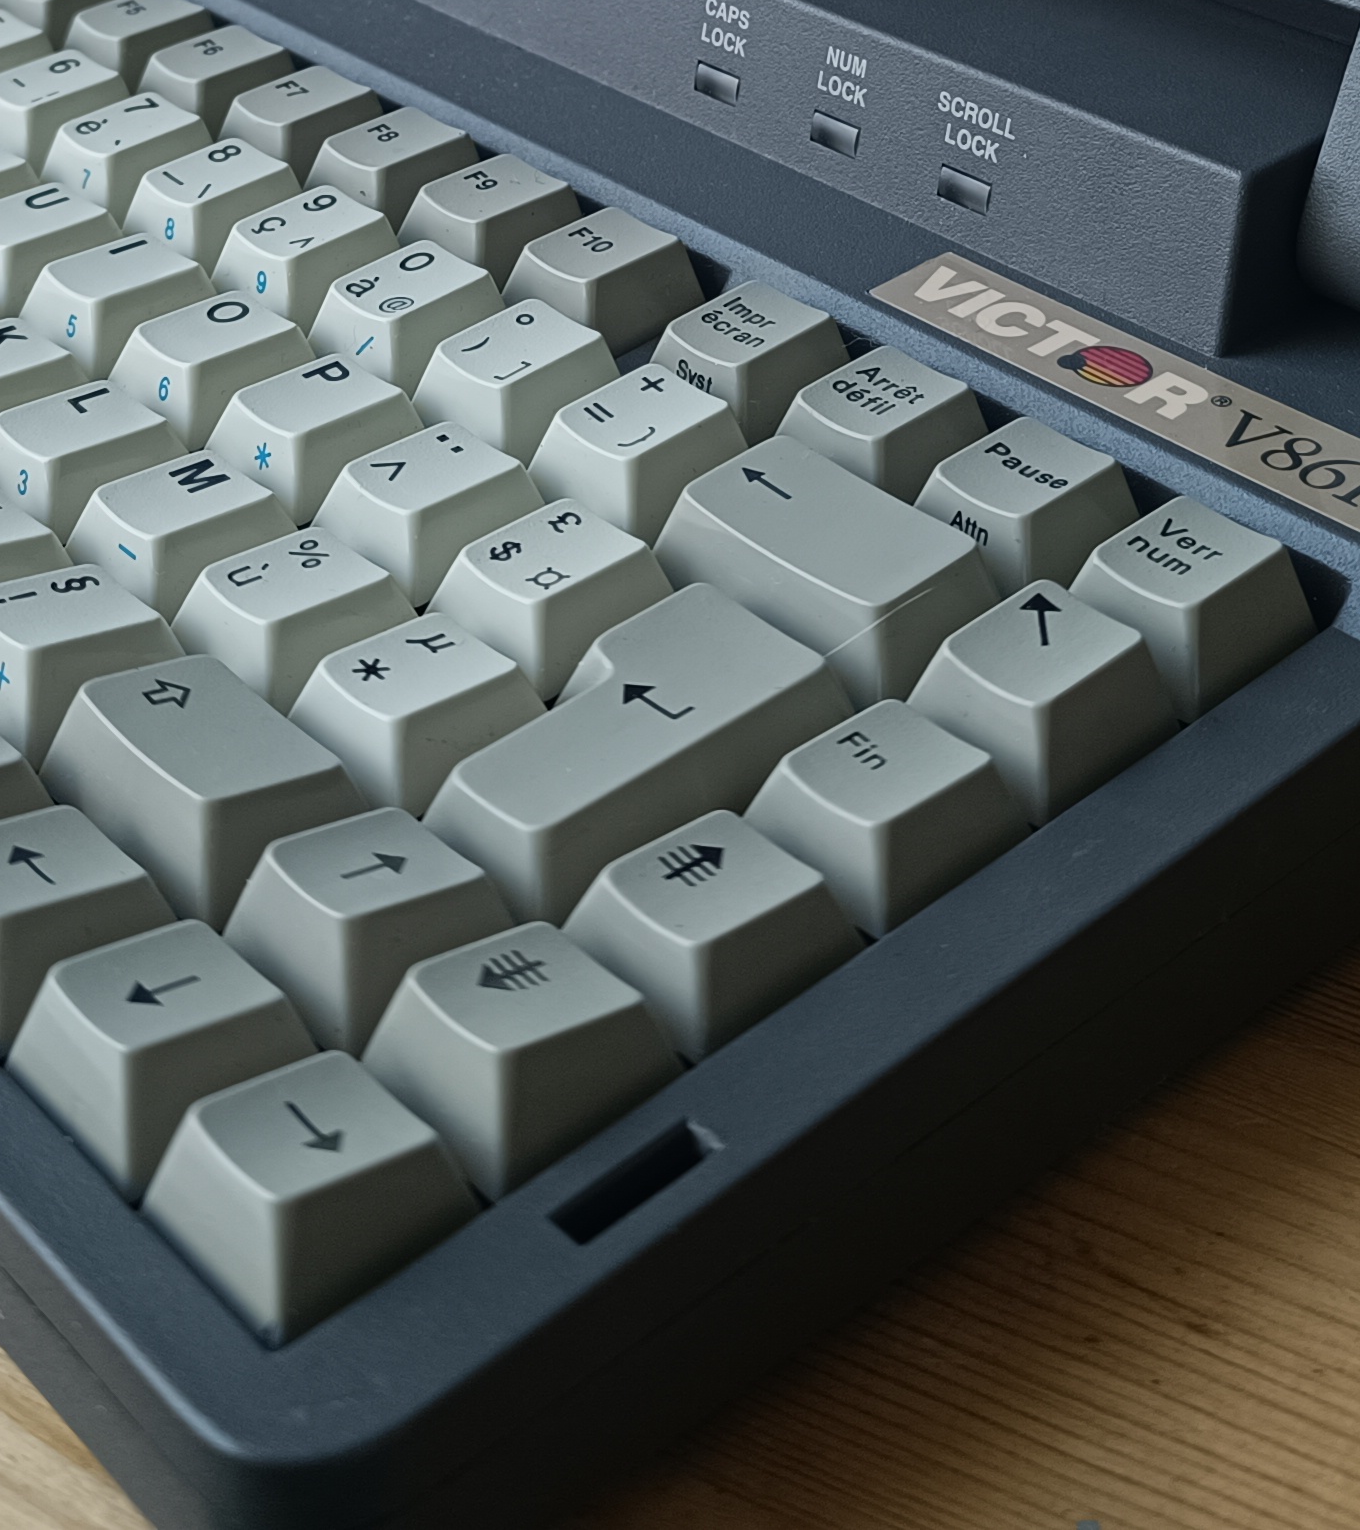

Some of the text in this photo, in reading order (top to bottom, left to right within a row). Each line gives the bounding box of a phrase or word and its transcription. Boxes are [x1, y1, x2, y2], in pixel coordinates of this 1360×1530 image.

[193, 38, 224, 57] F6
[700, 23, 747, 57] LOCK
[48, 58, 82, 74] 6
[826, 46, 868, 79] NUM
[275, 79, 310, 99] F7
[817, 71, 867, 108] LOCK
[123, 98, 160, 114] 7
[938, 91, 1016, 141] SCROLL
[367, 122, 400, 143] F8
[944, 123, 999, 164] LOCK
[207, 145, 242, 163] 8
[463, 170, 499, 192] F9
[25, 187, 71, 211] U
[302, 194, 337, 212] 9
[164, 217, 176, 240] 8
[568, 226, 614, 255] F10
[255, 270, 268, 294] 9
[66, 314, 78, 338] 5
[722, 296, 777, 331] Impr
[700, 308, 766, 349] écran
[302, 361, 350, 382] P
[157, 376, 171, 402] 6
[831, 378, 896, 417] défil
[855, 366, 926, 406] Arrêt
[67, 387, 111, 414] L
[168, 458, 231, 494] M
[983, 441, 1070, 490] Pause
[17, 469, 29, 495] 3
[949, 510, 990, 546] Attn
[1157, 518, 1224, 562] Verr
[1126, 533, 1193, 577] num
[836, 731, 889, 770] Fin
